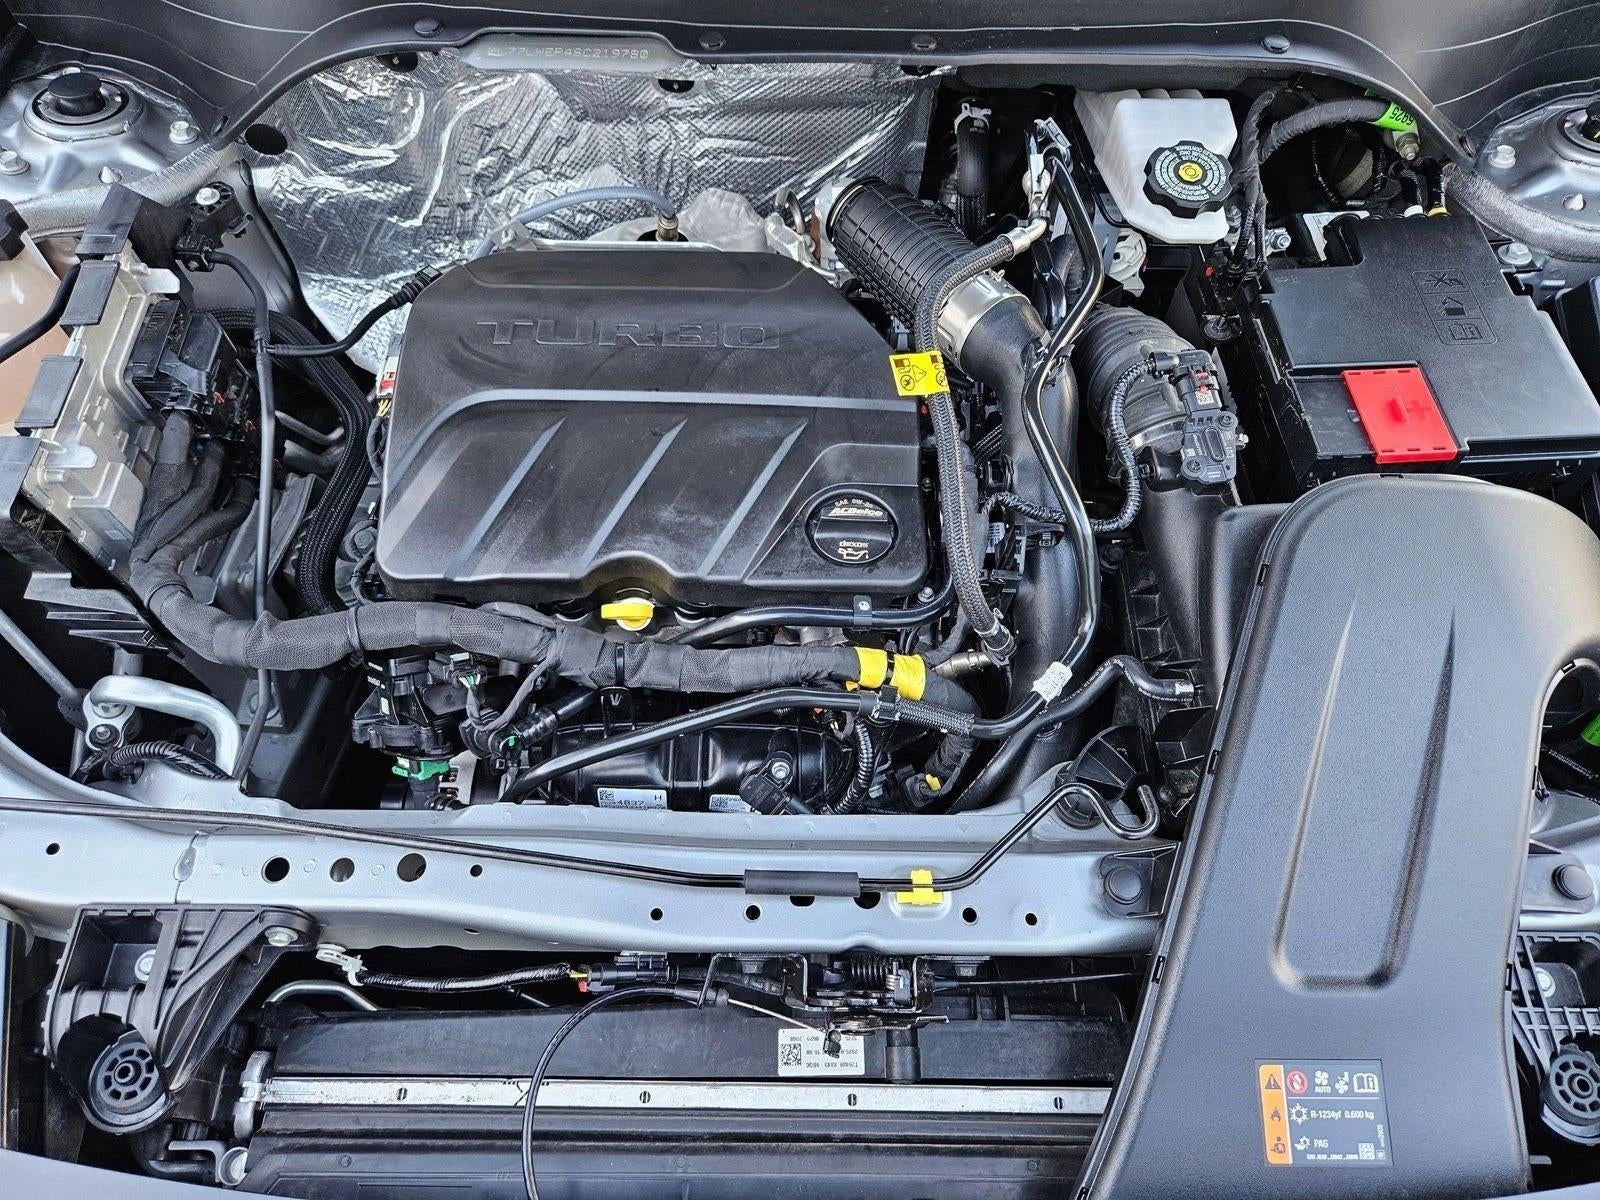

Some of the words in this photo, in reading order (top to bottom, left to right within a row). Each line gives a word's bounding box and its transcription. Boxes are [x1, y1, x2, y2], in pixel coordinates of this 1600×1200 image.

[476, 319, 780, 349] TURBO
[827, 507, 884, 517] ACDelco
[839, 540, 869, 548] dexos
[654, 794, 662, 802] H
[1310, 1110, 1342, 1120] R-1234yf
[1344, 1110, 1364, 1118] 0.600
[1365, 1110, 1374, 1120] kg
[1313, 1139, 1329, 1148] PAG
